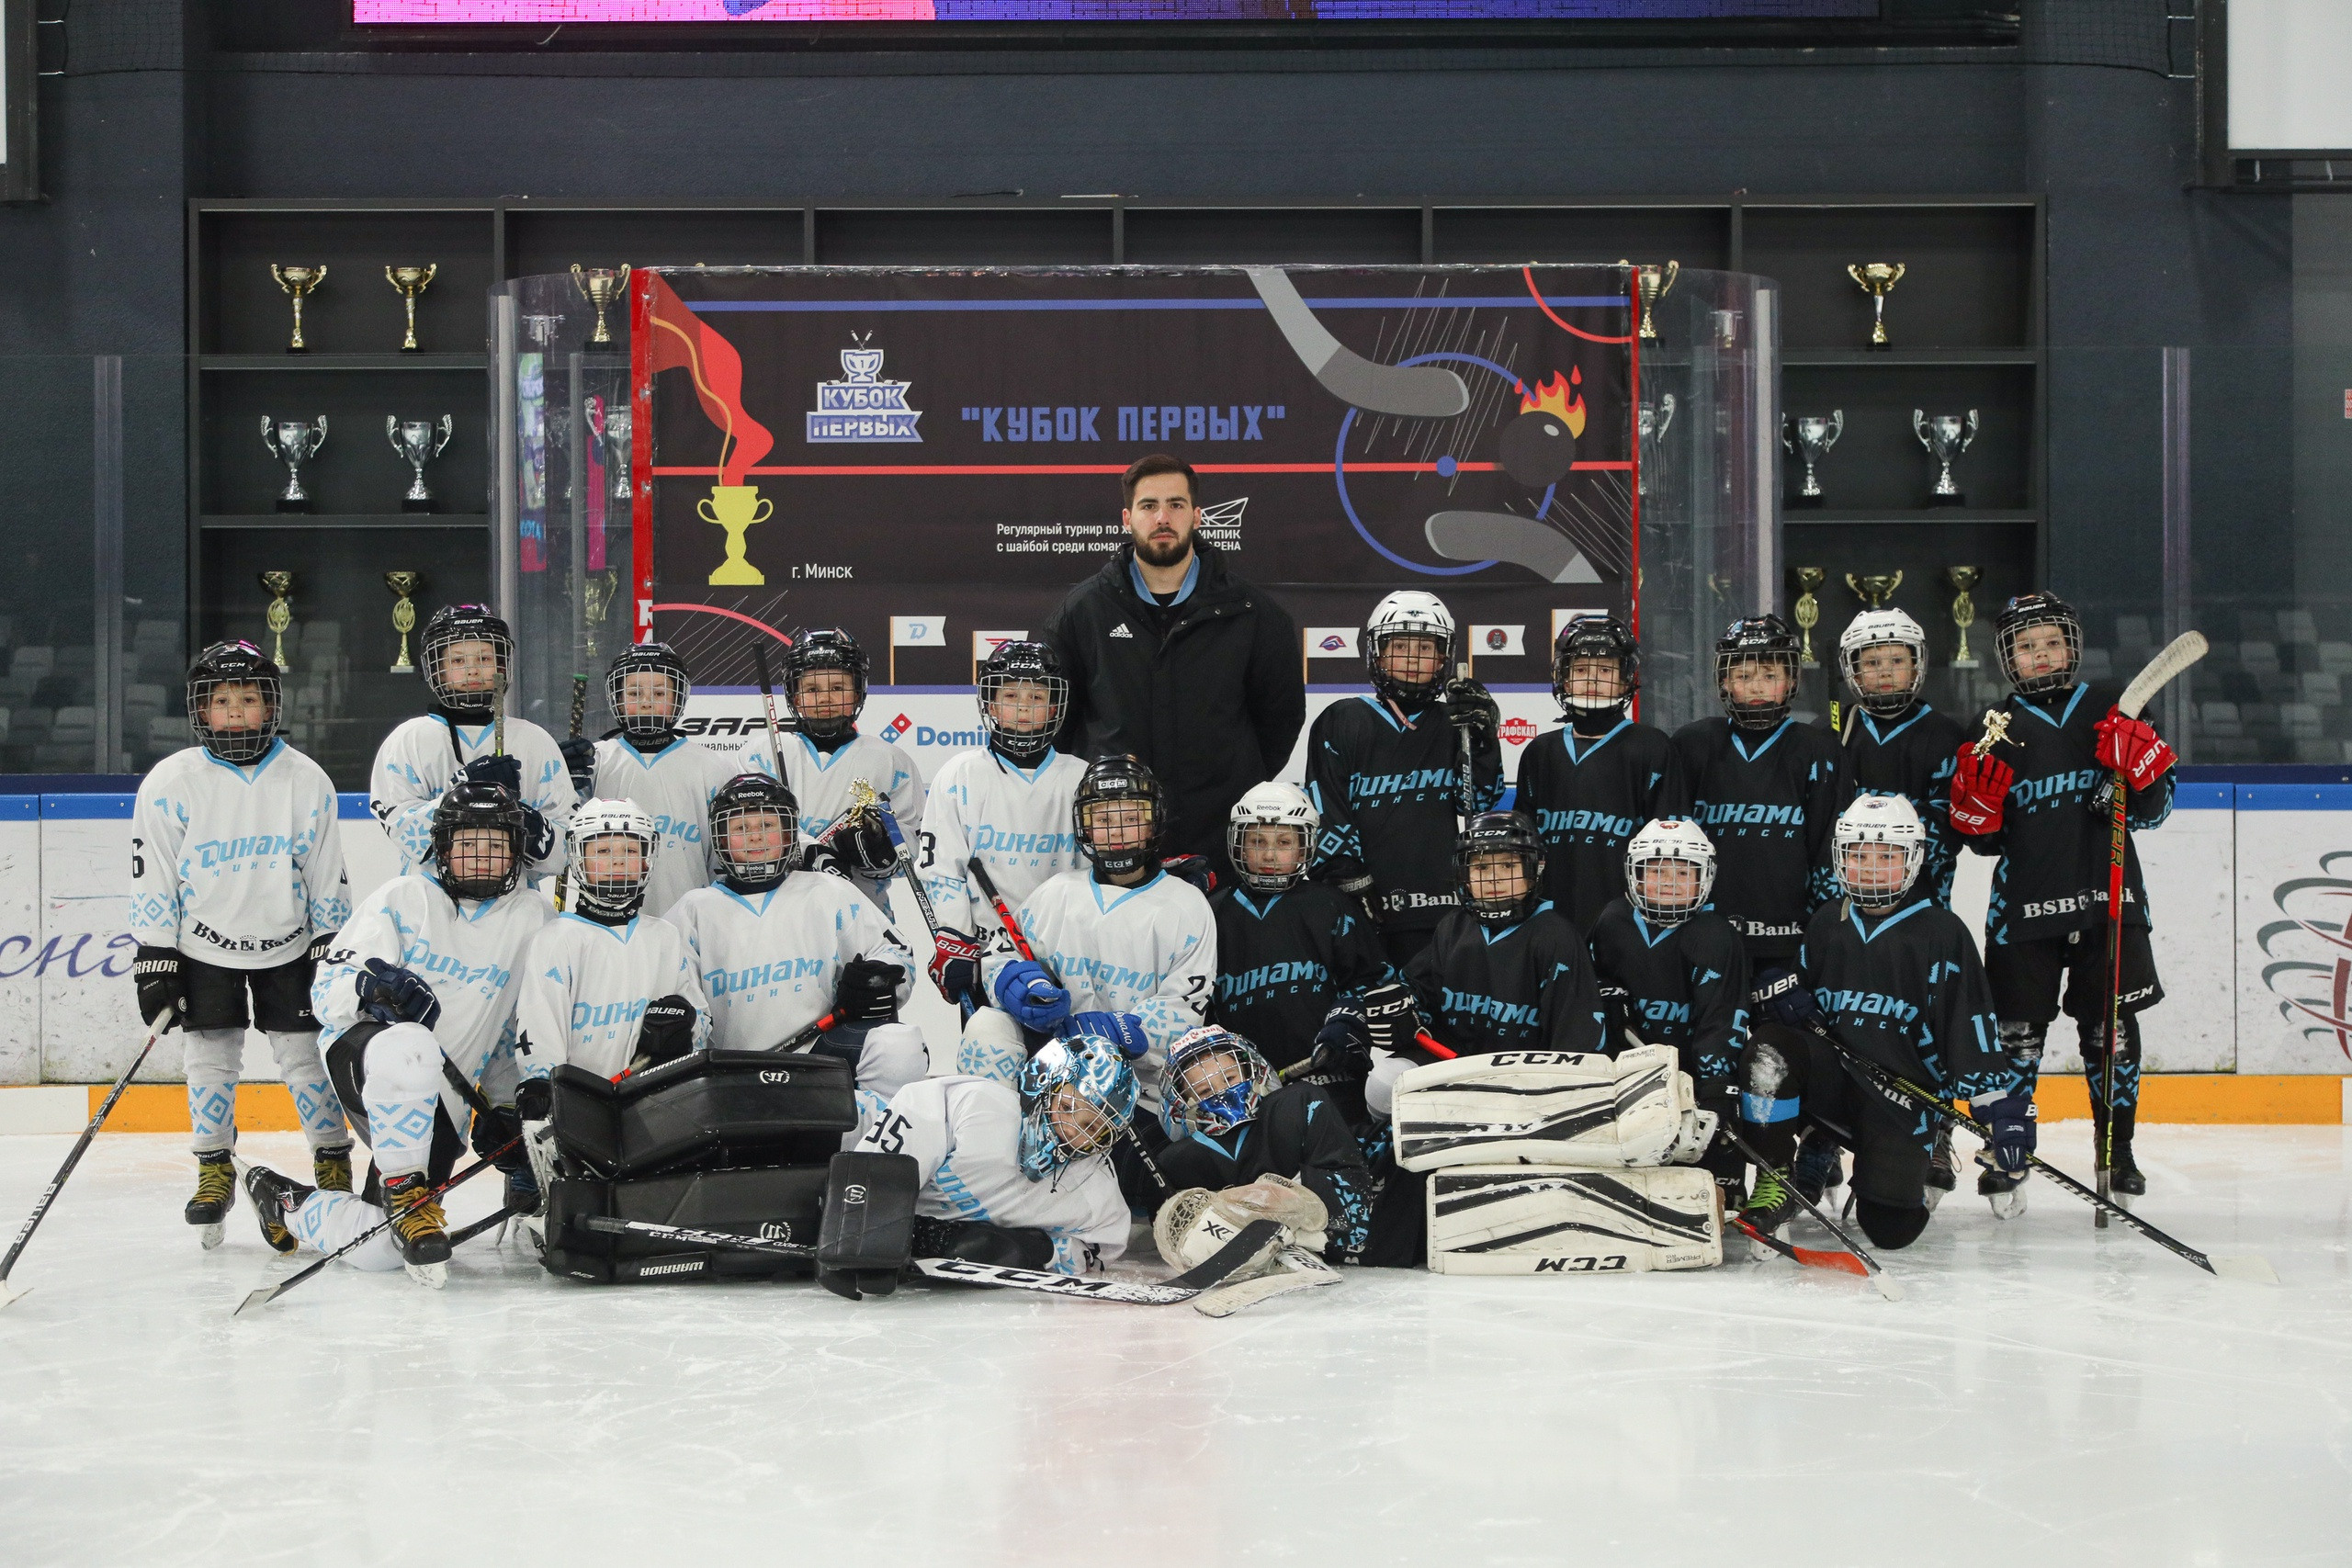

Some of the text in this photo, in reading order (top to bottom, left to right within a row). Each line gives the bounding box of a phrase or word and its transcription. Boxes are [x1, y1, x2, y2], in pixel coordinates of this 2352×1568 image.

[824, 388, 900, 408] КУБОК
[812, 415, 912, 436] ПЕРВЫХ
[961, 404, 1285, 443] "КУБОК ПЕРВЫХ"
[997, 523, 1060, 536] Регулярный
[1065, 525, 1102, 536] турнир
[1105, 525, 1119, 535] по
[997, 543, 1003, 552] с
[1006, 540, 1049, 552] шайбой
[1052, 541, 1083, 555] среди
[791, 563, 854, 579] г. Минск
[2018, 603, 2047, 613] BAUER
[1109, 631, 1134, 639] adidas
[1010, 662, 1042, 671] CCM
[1098, 779, 1128, 789] CCM
[737, 790, 765, 799] Reebok
[1256, 804, 1282, 812] Reebok
[1473, 829, 1509, 838] CCM
[916, 890, 939, 931] NEXUS
[2022, 897, 2077, 919] BSB
[1747, 920, 1804, 937] Bank
[1365, 994, 1416, 1018] CCM
[1489, 1053, 1586, 1067] CCM
[639, 1260, 705, 1277] WARRIOR
[1534, 1255, 1628, 1273] CCM
[934, 1260, 1111, 1292] CCM
